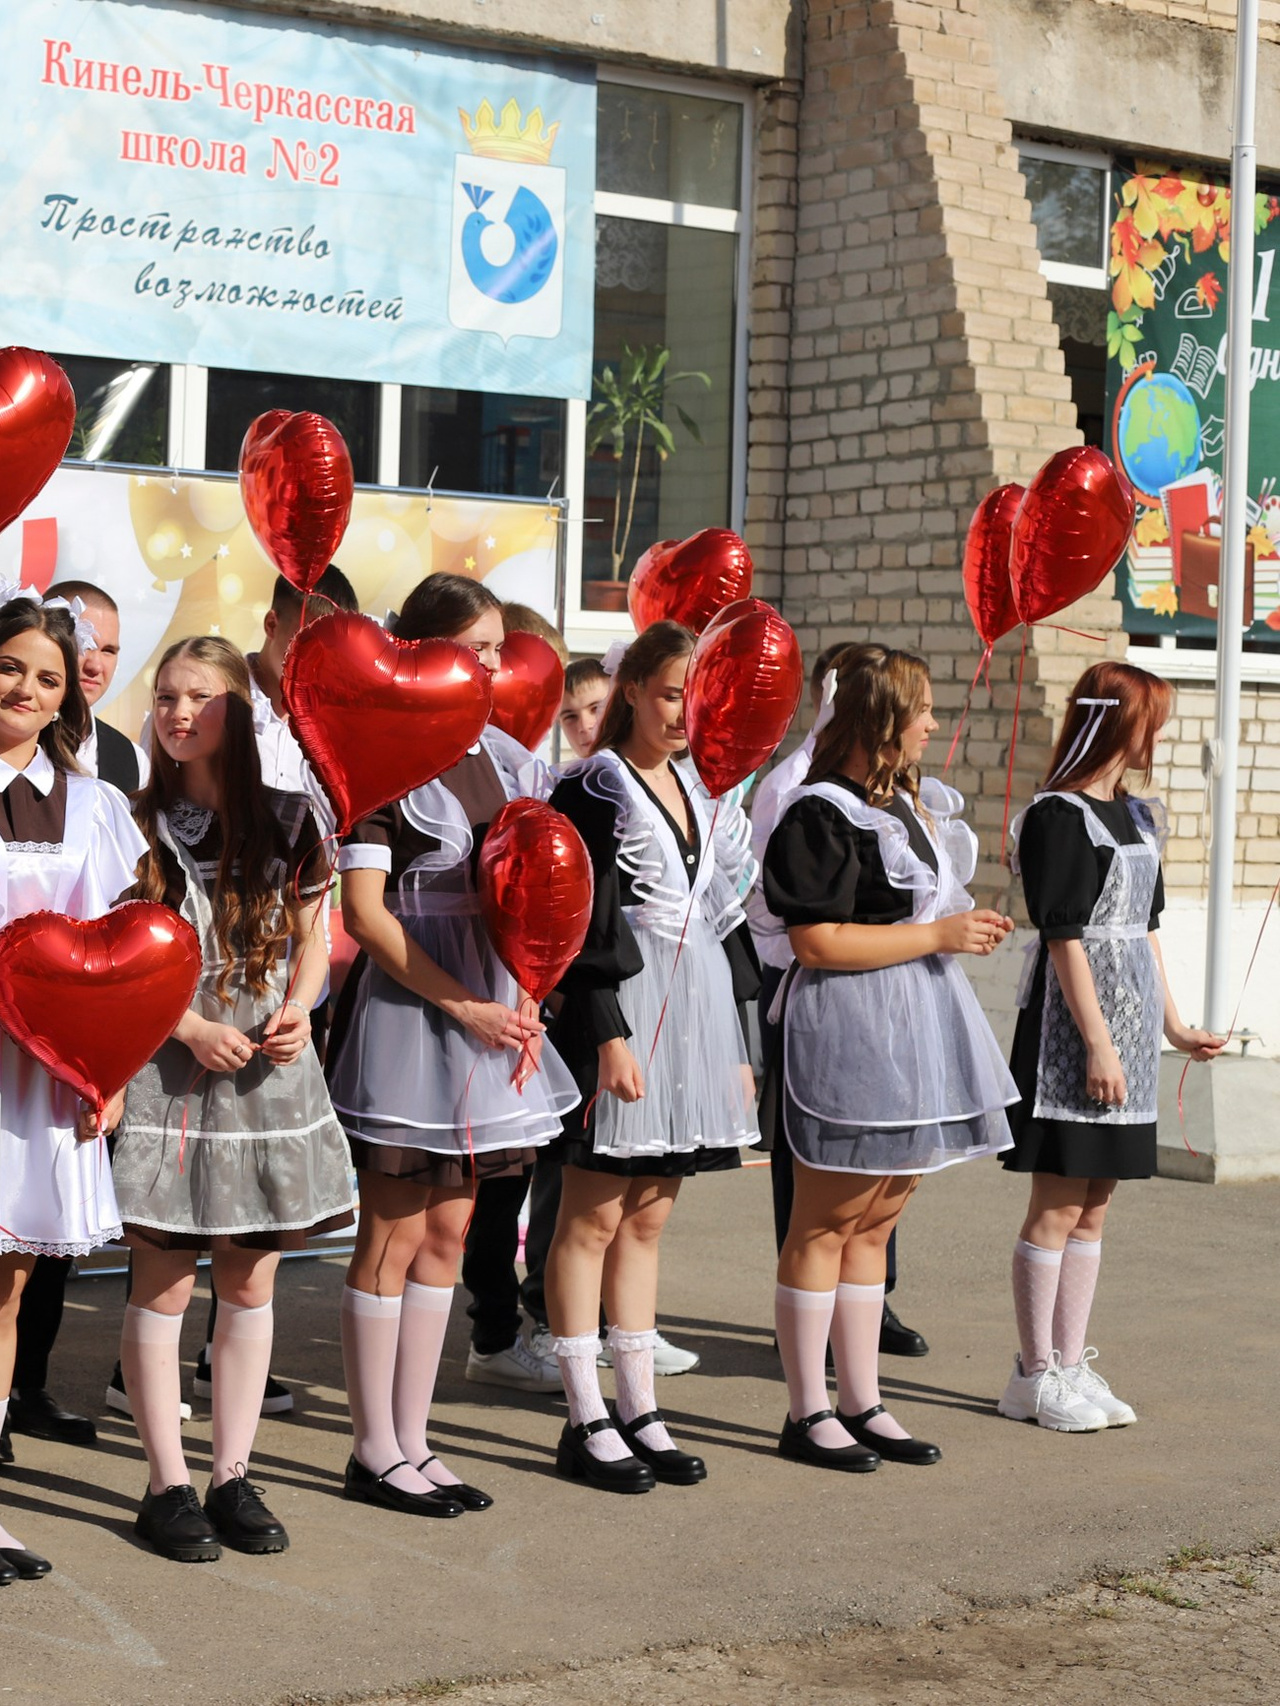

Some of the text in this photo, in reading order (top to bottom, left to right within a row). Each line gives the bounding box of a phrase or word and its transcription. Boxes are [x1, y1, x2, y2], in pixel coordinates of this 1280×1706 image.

[42, 39, 416, 135] Кинель-Черкасская
[120, 130, 340, 187] школа №2
[41, 194, 331, 258] Пространство
[133, 262, 404, 322] возможностей
